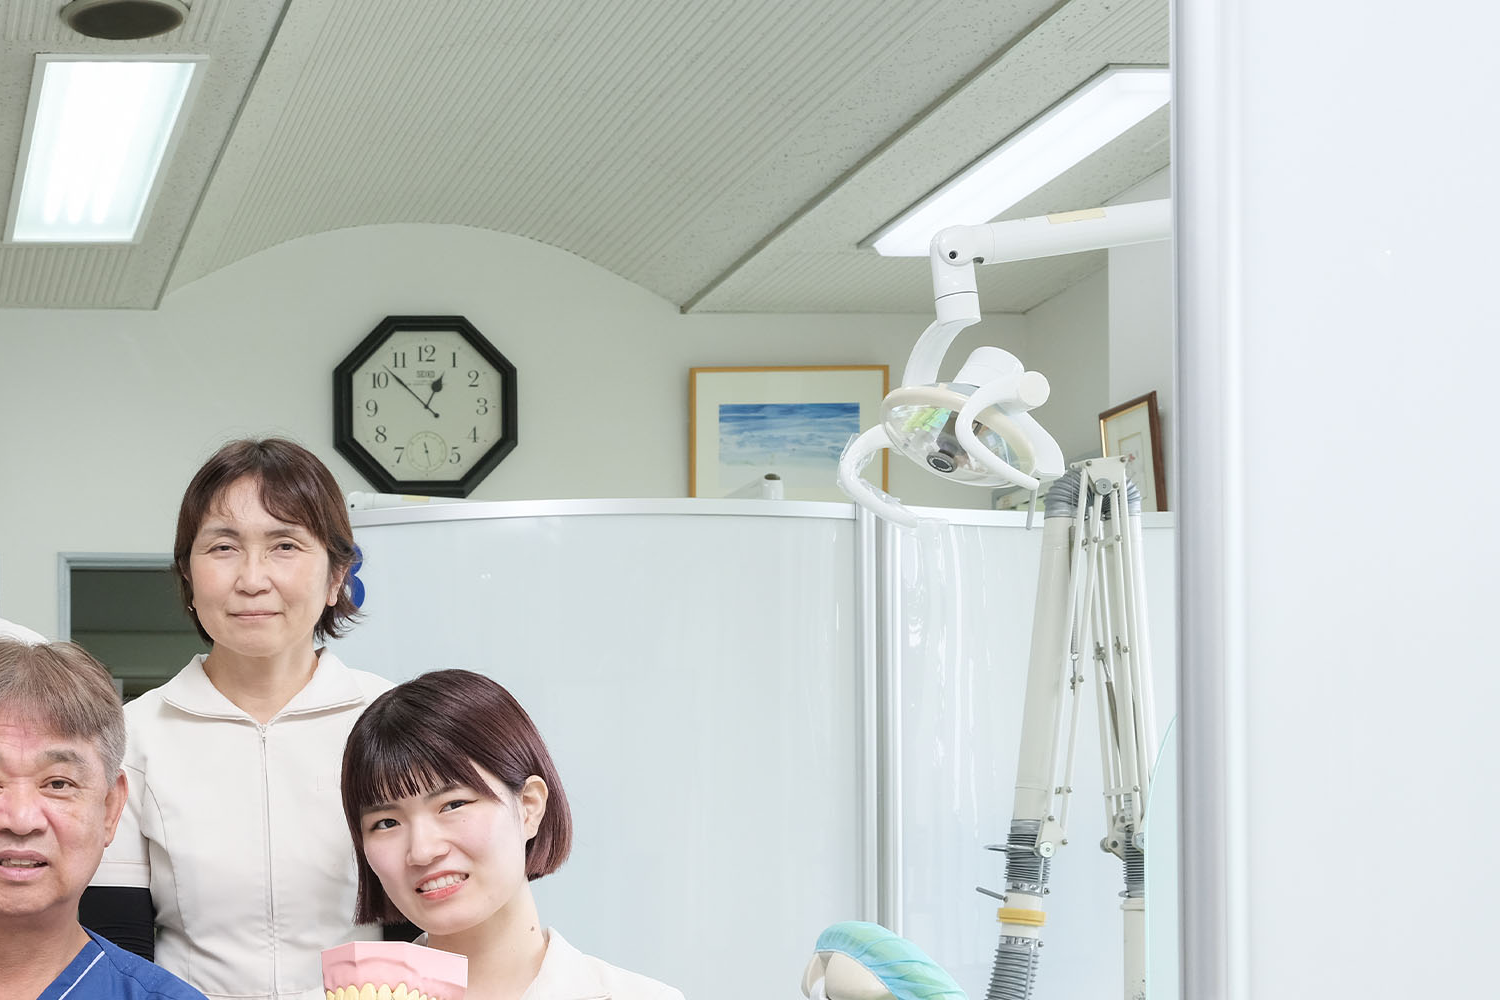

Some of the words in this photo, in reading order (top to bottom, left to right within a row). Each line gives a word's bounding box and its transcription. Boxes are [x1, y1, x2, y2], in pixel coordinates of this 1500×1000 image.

[393, 351, 407, 368] 11
[417, 344, 436, 362] 12
[451, 351, 458, 368] 1
[372, 372, 389, 389] 10
[468, 370, 480, 387] 2
[365, 399, 379, 417] 9
[476, 398, 488, 416] 3
[375, 426, 387, 443] 8
[467, 426, 479, 443] 4
[394, 447, 405, 464] 7
[449, 446, 461, 464] 5
